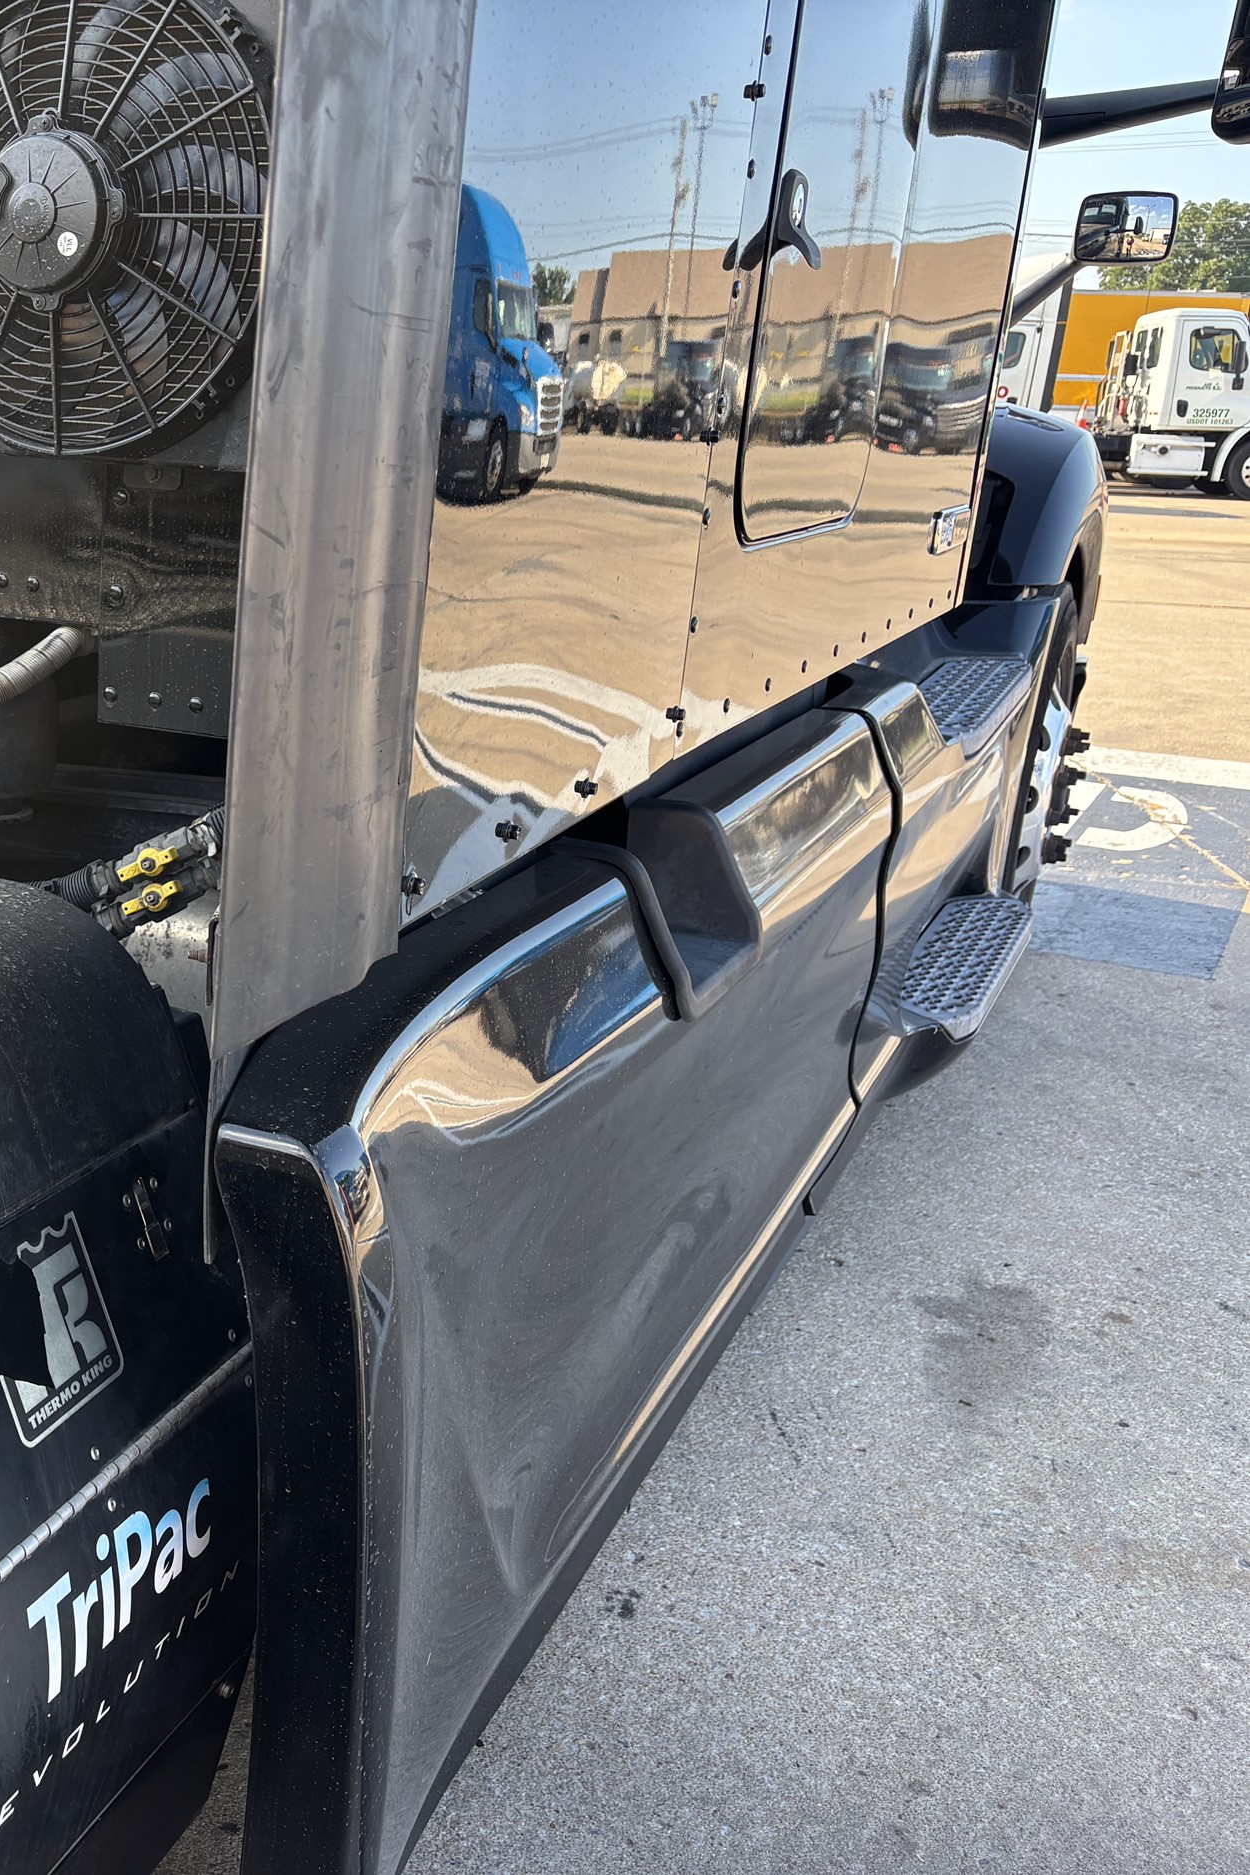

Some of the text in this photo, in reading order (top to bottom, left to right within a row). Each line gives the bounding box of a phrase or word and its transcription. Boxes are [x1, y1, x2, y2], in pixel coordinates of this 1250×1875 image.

[1192, 408, 1230, 418] 325977
[27, 1355, 113, 1430] THERMO KING
[26, 1477, 211, 1704] TriPac
